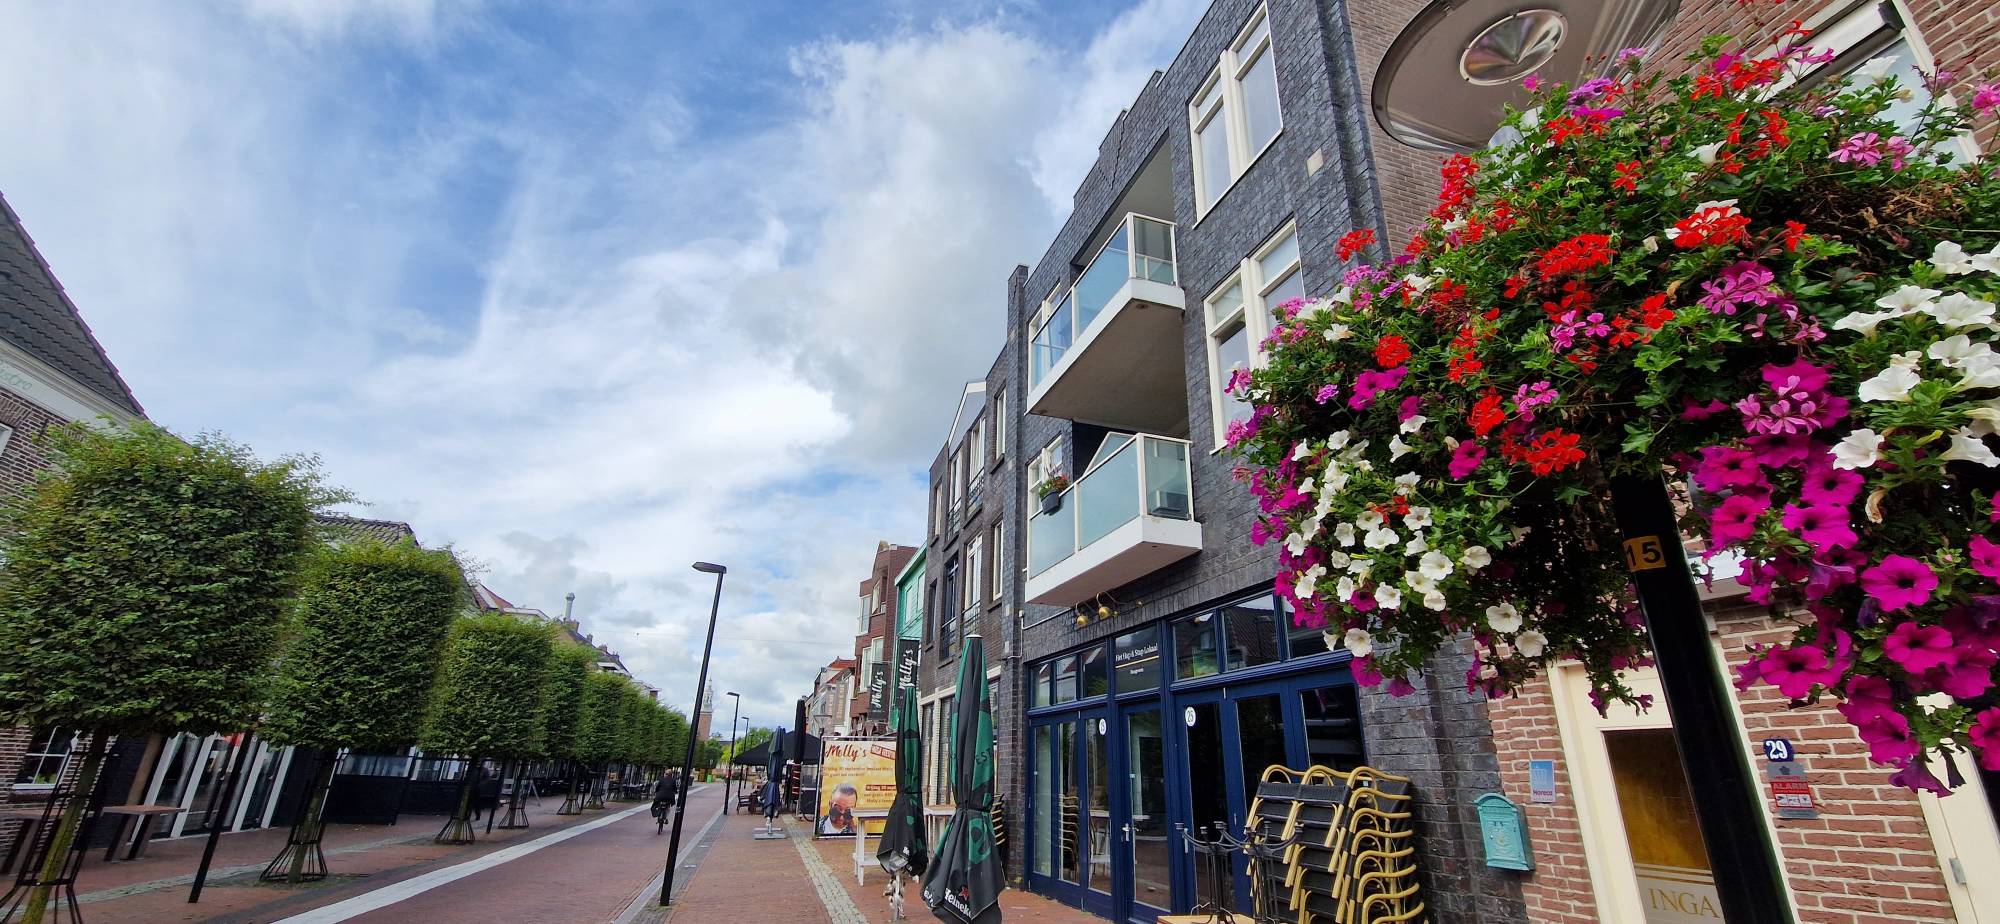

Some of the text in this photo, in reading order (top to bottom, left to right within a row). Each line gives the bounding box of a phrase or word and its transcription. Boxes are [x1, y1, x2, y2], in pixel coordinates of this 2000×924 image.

[1627, 541, 1661, 565] 15
[871, 671, 887, 709] Molly's
[826, 744, 867, 762] Molly's
[1765, 740, 1788, 760] 29
[1773, 782, 1808, 790] ALARM
